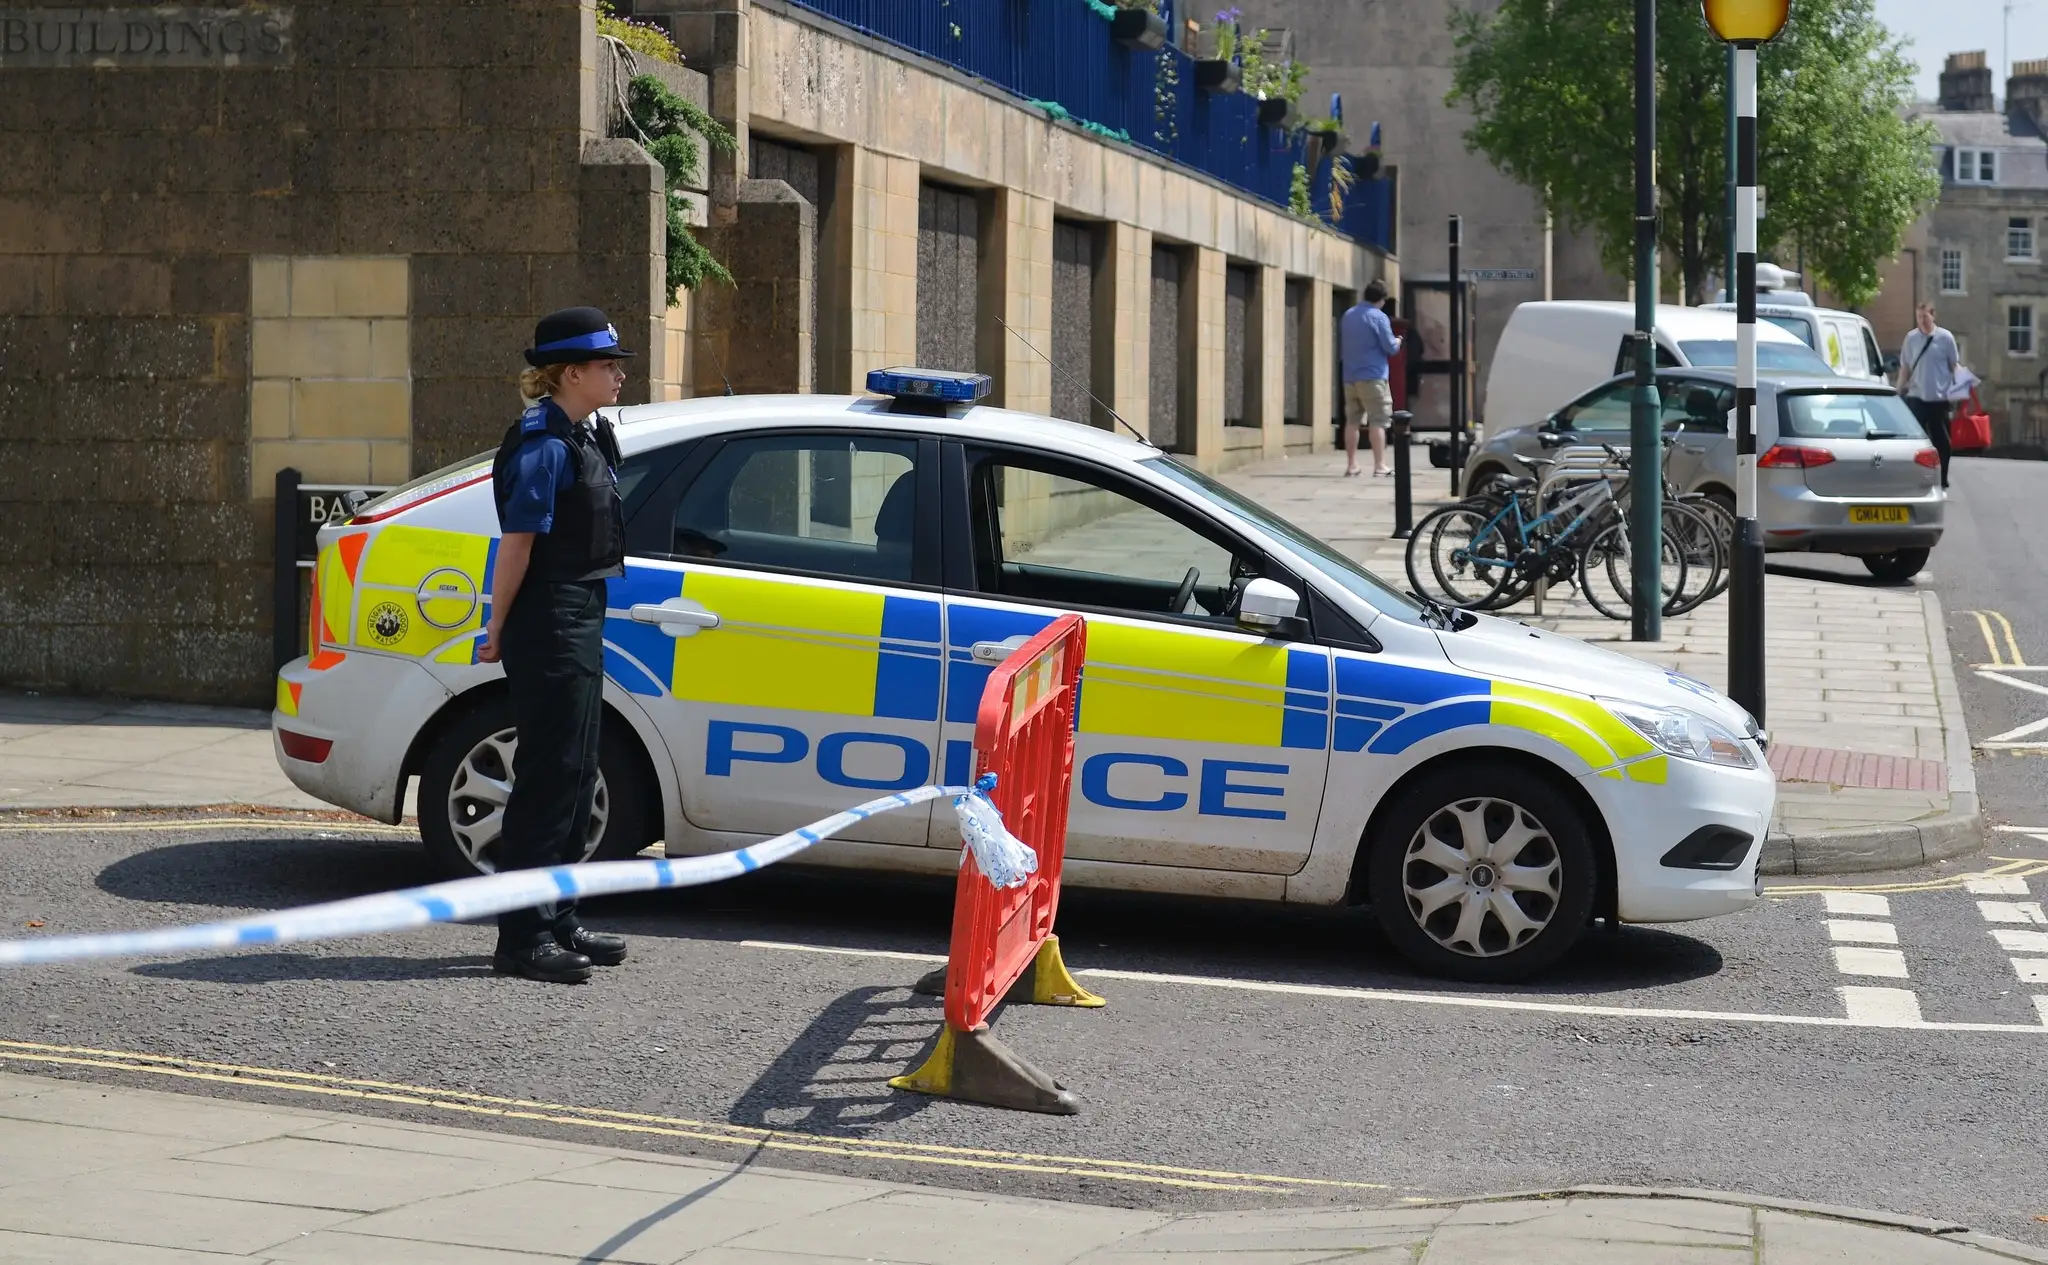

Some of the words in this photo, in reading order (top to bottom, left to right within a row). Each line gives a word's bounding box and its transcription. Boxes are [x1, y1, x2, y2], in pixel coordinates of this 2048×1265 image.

[2, 19, 283, 55] BUILDINGS
[1882, 508, 1903, 521] LUA
[370, 604, 406, 633] NEIGHBOURHOOD
[375, 635, 399, 644] WATCH
[705, 720, 1290, 820] POCE
